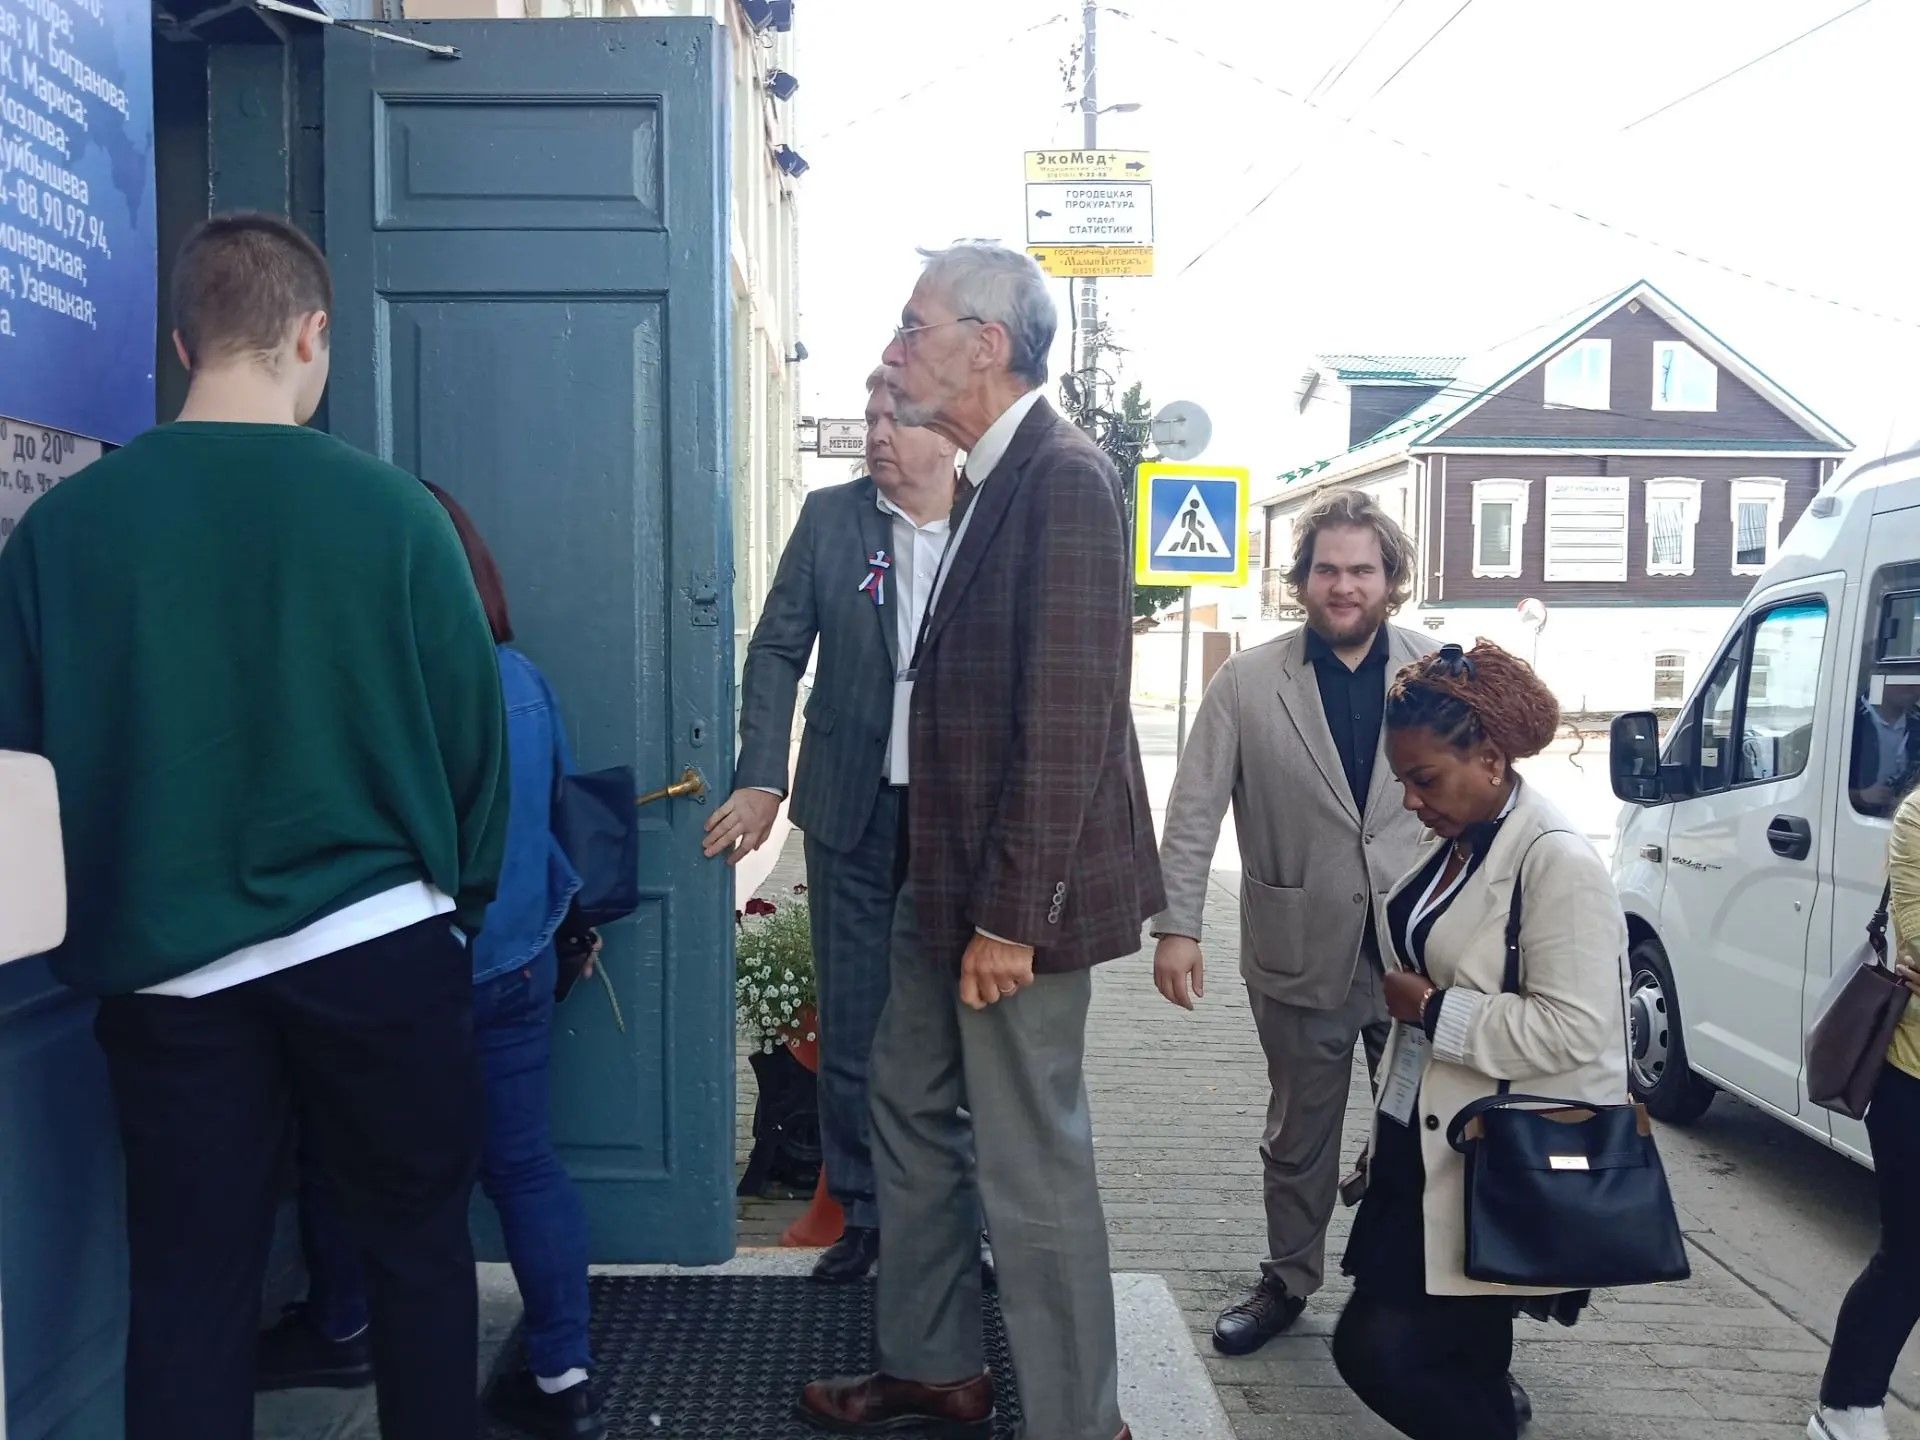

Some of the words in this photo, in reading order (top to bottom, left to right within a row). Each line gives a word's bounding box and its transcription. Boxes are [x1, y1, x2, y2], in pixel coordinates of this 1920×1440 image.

[26, 16, 44, 59] И.
[49, 32, 129, 120] Богданова;
[22, 56, 88, 132] Маркса;
[1066, 190, 1133, 199] ГОРОДЕЦКАЯ
[1065, 201, 1135, 209] ПРОКУРАТУРА
[1068, 226, 1133, 234] СТАТИСТИКИ
[20, 264, 96, 330] Узенькая;
[13, 434, 36, 463] до
[829, 439, 863, 449] МЕТЕОР
